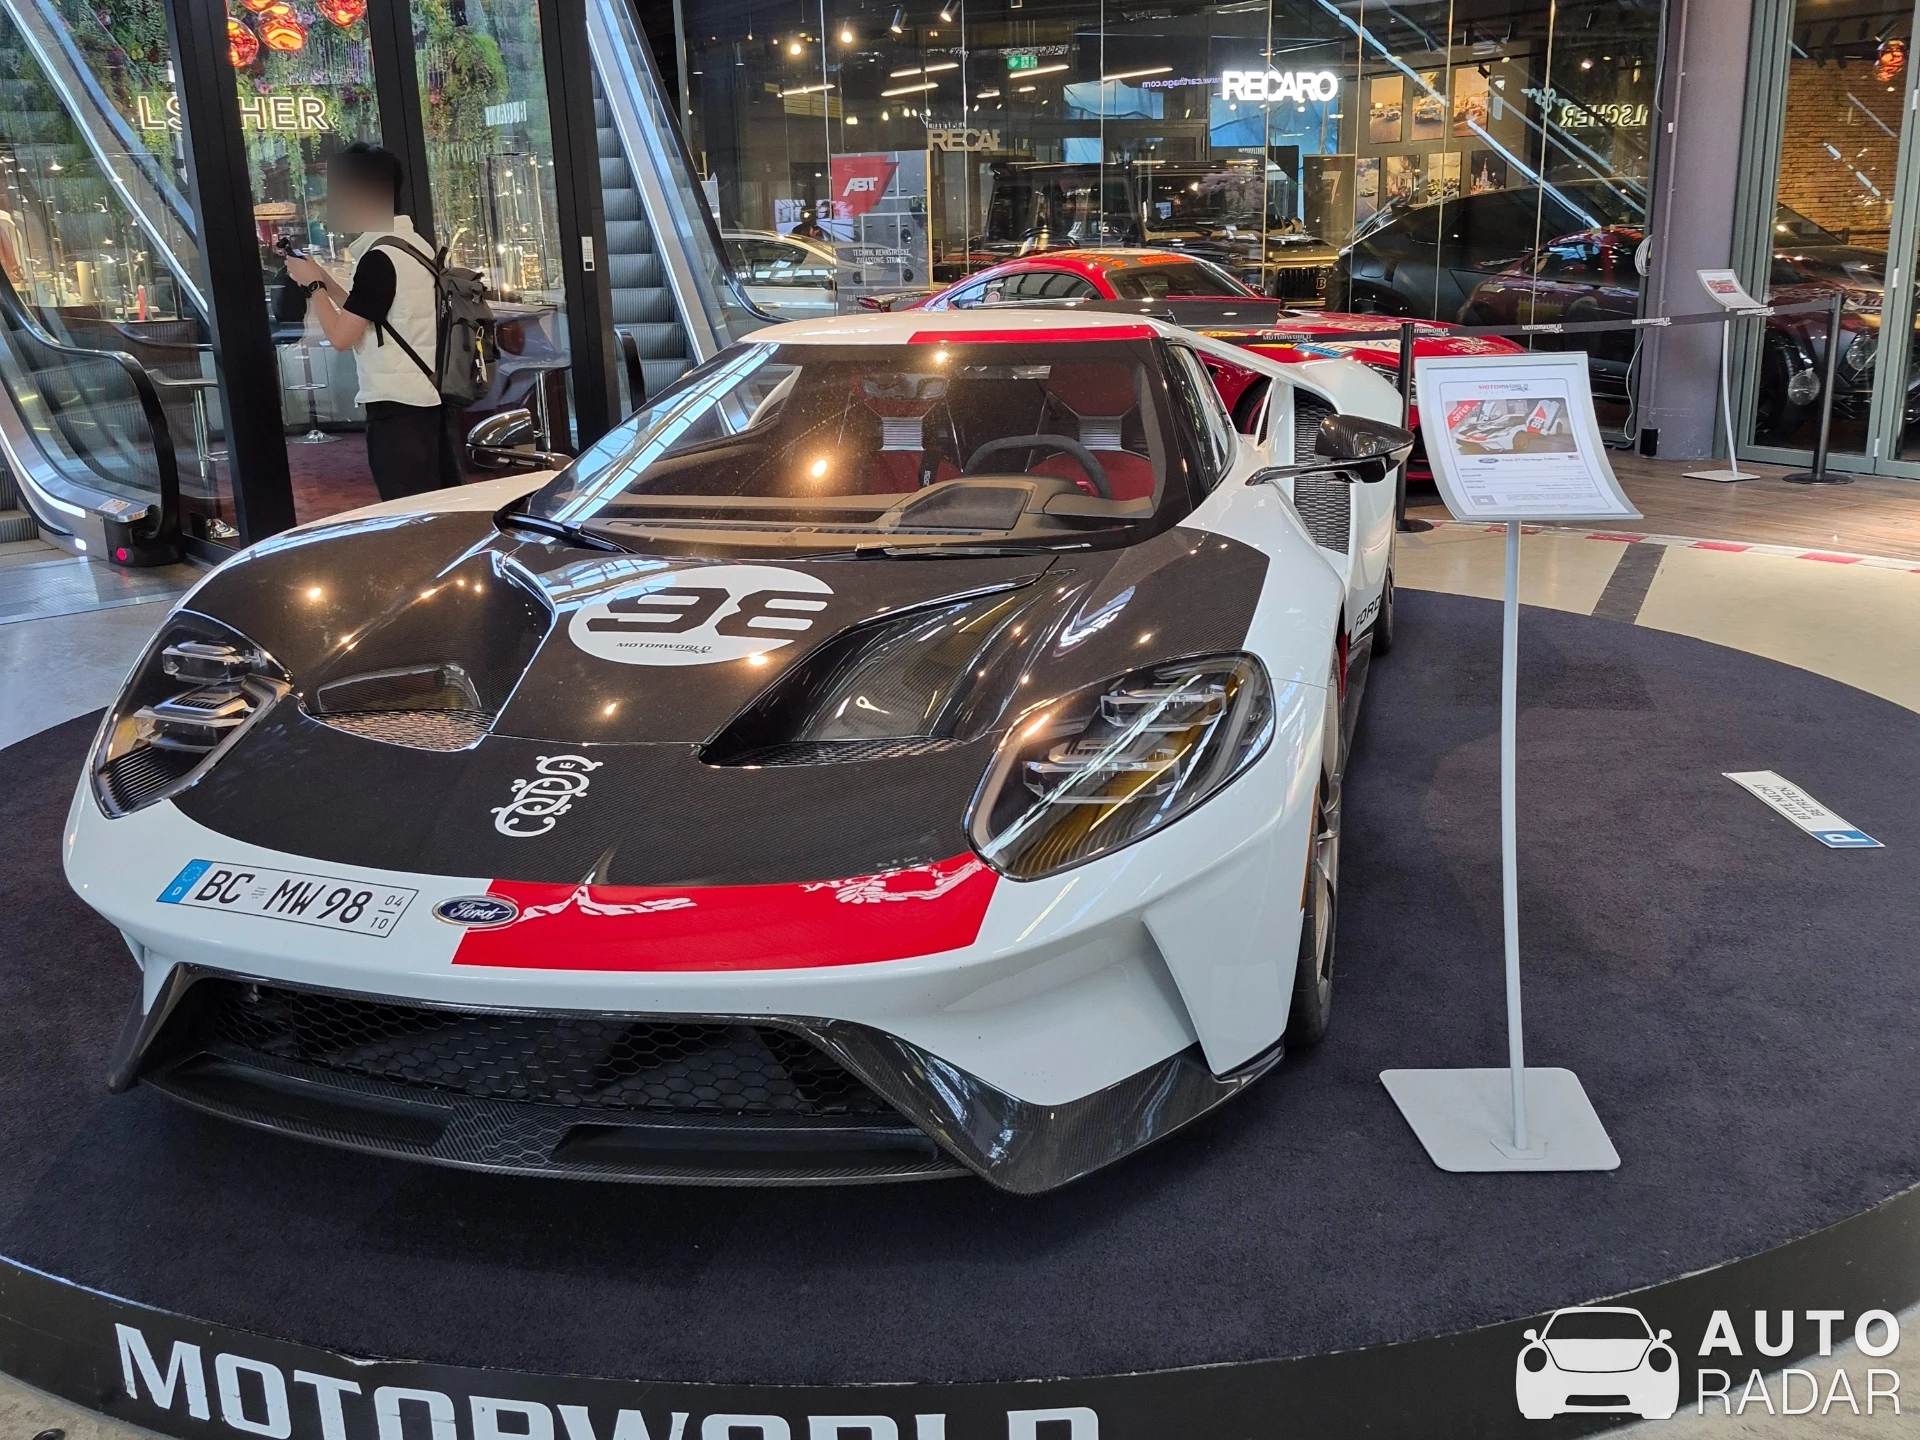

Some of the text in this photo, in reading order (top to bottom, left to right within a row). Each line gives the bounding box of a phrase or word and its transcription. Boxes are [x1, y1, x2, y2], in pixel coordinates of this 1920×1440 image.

[1222, 71, 1338, 101] RECARO
[138, 96, 329, 130] LSHER
[843, 177, 878, 196] ABT
[1452, 404, 1472, 422] OFFER
[616, 642, 712, 652] MOTORWORLD
[1753, 784, 1811, 820] BITTE NICHT
[172, 886, 182, 896] D
[194, 869, 255, 904] BC
[263, 879, 328, 917] MW
[316, 887, 374, 924] 98
[384, 894, 404, 907] 04
[449, 901, 502, 920] Ford
[370, 917, 389, 930] 10
